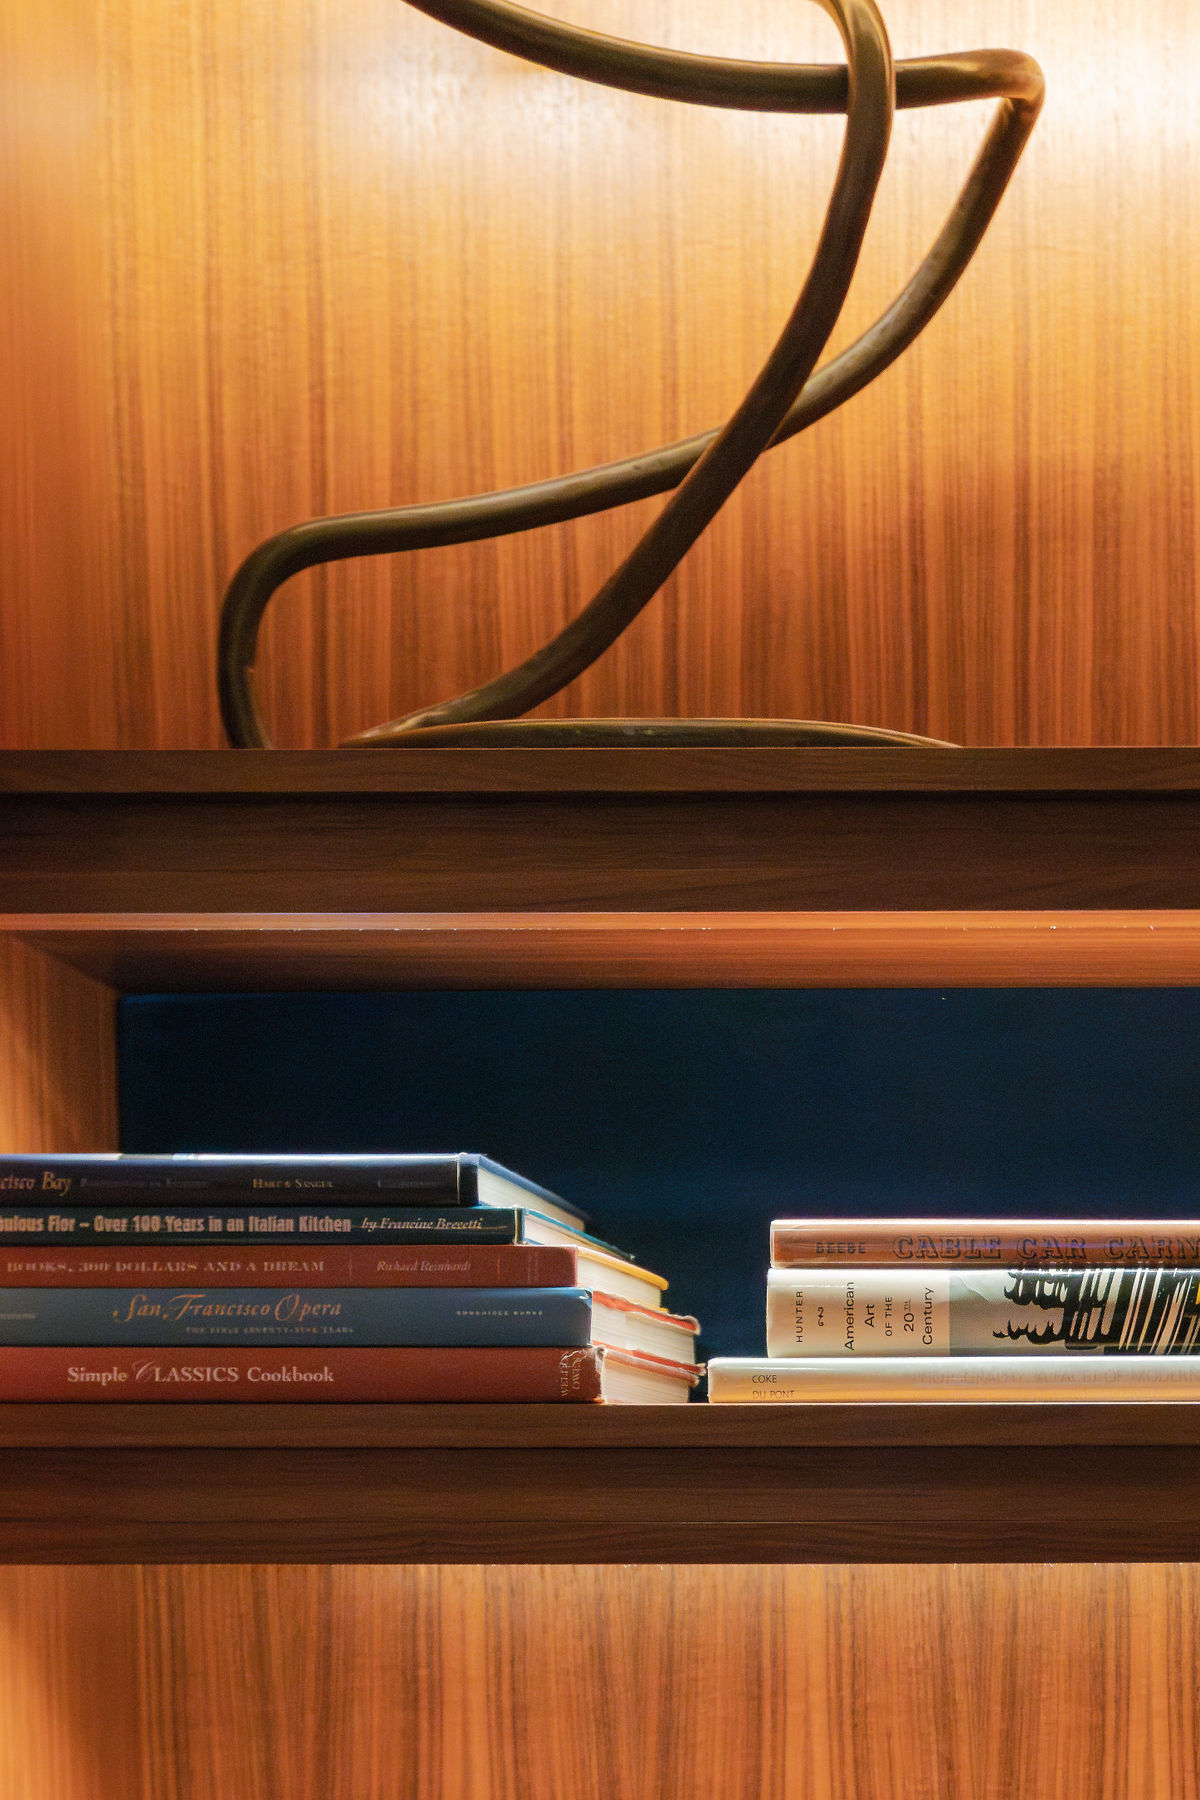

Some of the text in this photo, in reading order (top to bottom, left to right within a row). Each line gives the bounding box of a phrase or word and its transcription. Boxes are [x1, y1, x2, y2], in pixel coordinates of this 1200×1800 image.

[42, 1171, 72, 1197] Bay
[94, 1215, 128, 1232] Over
[133, 1215, 161, 1232] 100
[165, 1215, 205, 1232] Years
[208, 1216, 222, 1232] in
[226, 1218, 244, 1232] an
[249, 1215, 294, 1232] Italian
[299, 1215, 351, 1232] Kitchen
[361, 1217, 377, 1233] by
[379, 1217, 433, 1231] Francine
[815, 1241, 866, 1254] BEEBE
[893, 1235, 1001, 1259] CABLE
[1017, 1235, 1086, 1259] CAR
[115, 1261, 198, 1273] DOLLARS
[204, 1261, 241, 1272] AND
[246, 1261, 257, 1272] A
[263, 1261, 325, 1272] DREAM
[112, 1293, 342, 1324] San Francisco Opera
[795, 1291, 804, 1343] HUNTER
[843, 1281, 855, 1351] American
[864, 1303, 876, 1328] Art
[884, 1296, 893, 1337] OF THE
[922, 1287, 935, 1345] Century
[67, 1360, 334, 1386] Simple CLASSICS Cookbook
[751, 1374, 778, 1384] COKE
[752, 1390, 795, 1399] DU PONT
